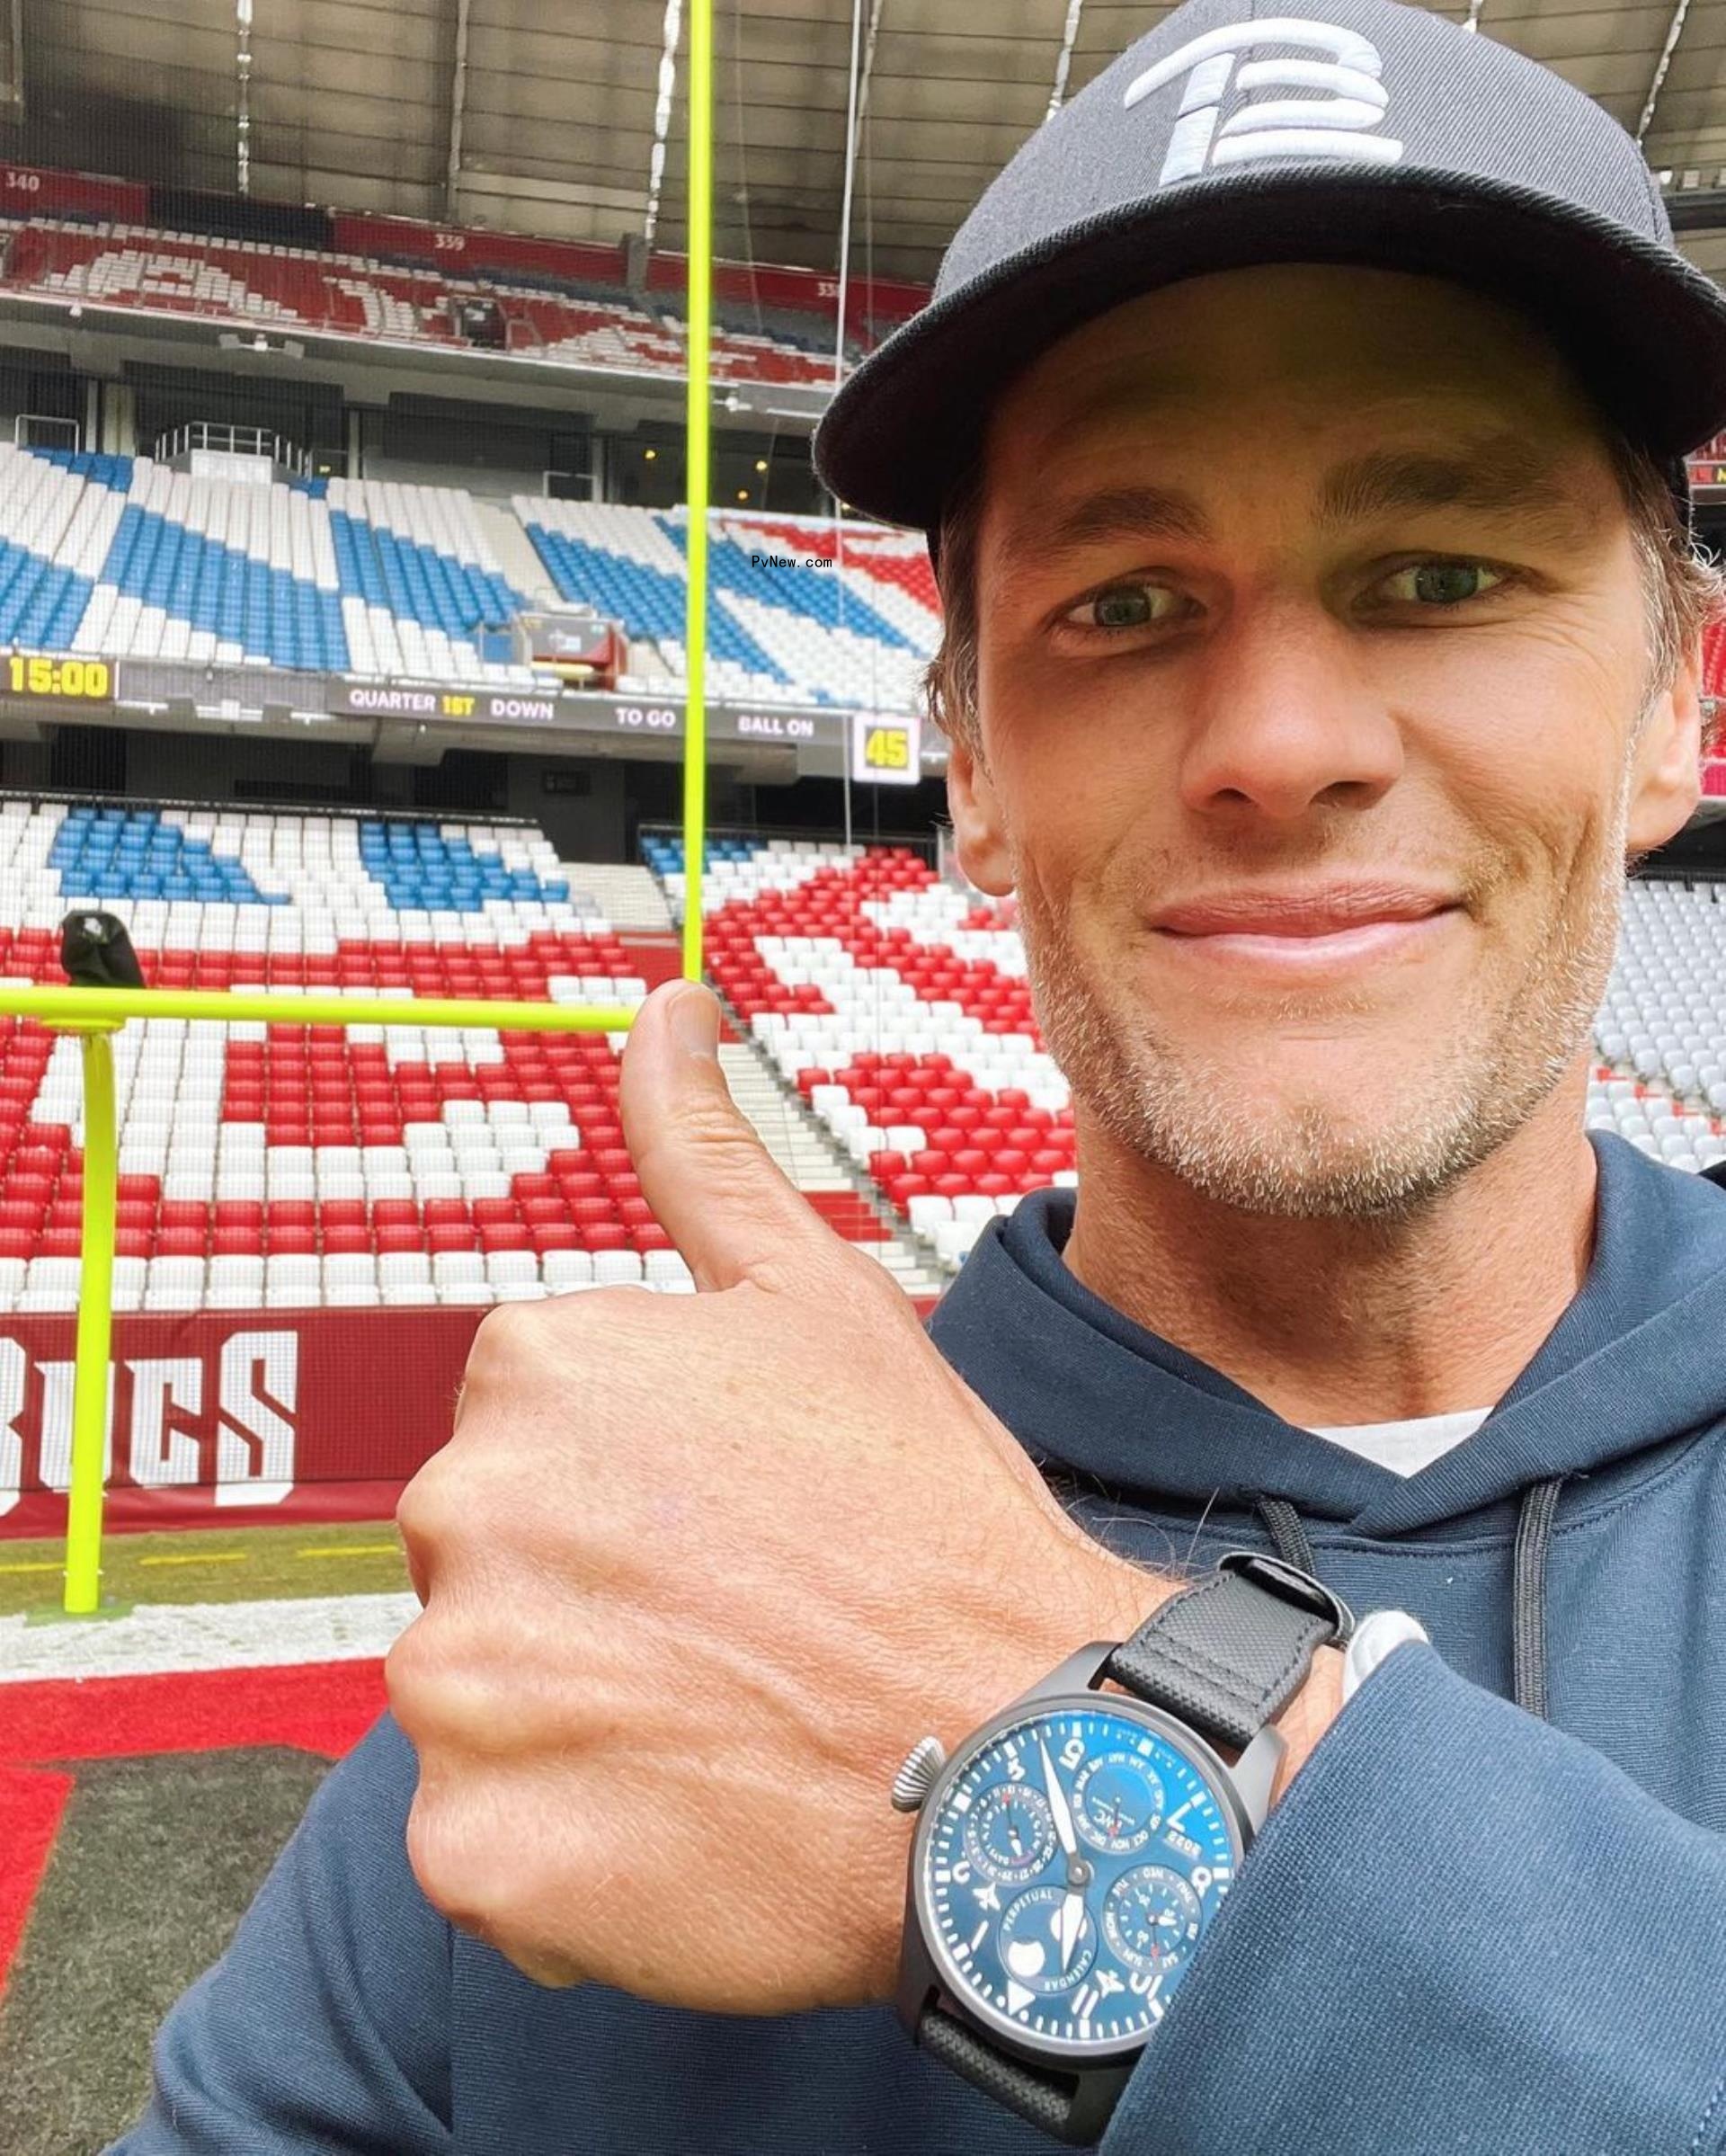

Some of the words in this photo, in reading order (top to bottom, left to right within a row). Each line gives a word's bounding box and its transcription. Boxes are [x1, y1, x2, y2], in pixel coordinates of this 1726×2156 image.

[5, 172, 40, 192] 340
[817, 281, 843, 298] 33
[9, 656, 109, 698] 15:00
[350, 689, 435, 711] QUARTER
[442, 695, 475, 717] 1ST
[491, 698, 555, 720] DOWN
[616, 707, 642, 726] TO
[646, 709, 676, 728] GO
[738, 715, 783, 735] BALL
[787, 719, 814, 737] ON
[866, 728, 909, 769] 45
[1167, 1800, 1194, 1832] 7
[1167, 1831, 1203, 1858] 2022
[1002, 1889, 1053, 1931] PERPETUAL
[1044, 1948, 1092, 1992] CALENDAR
